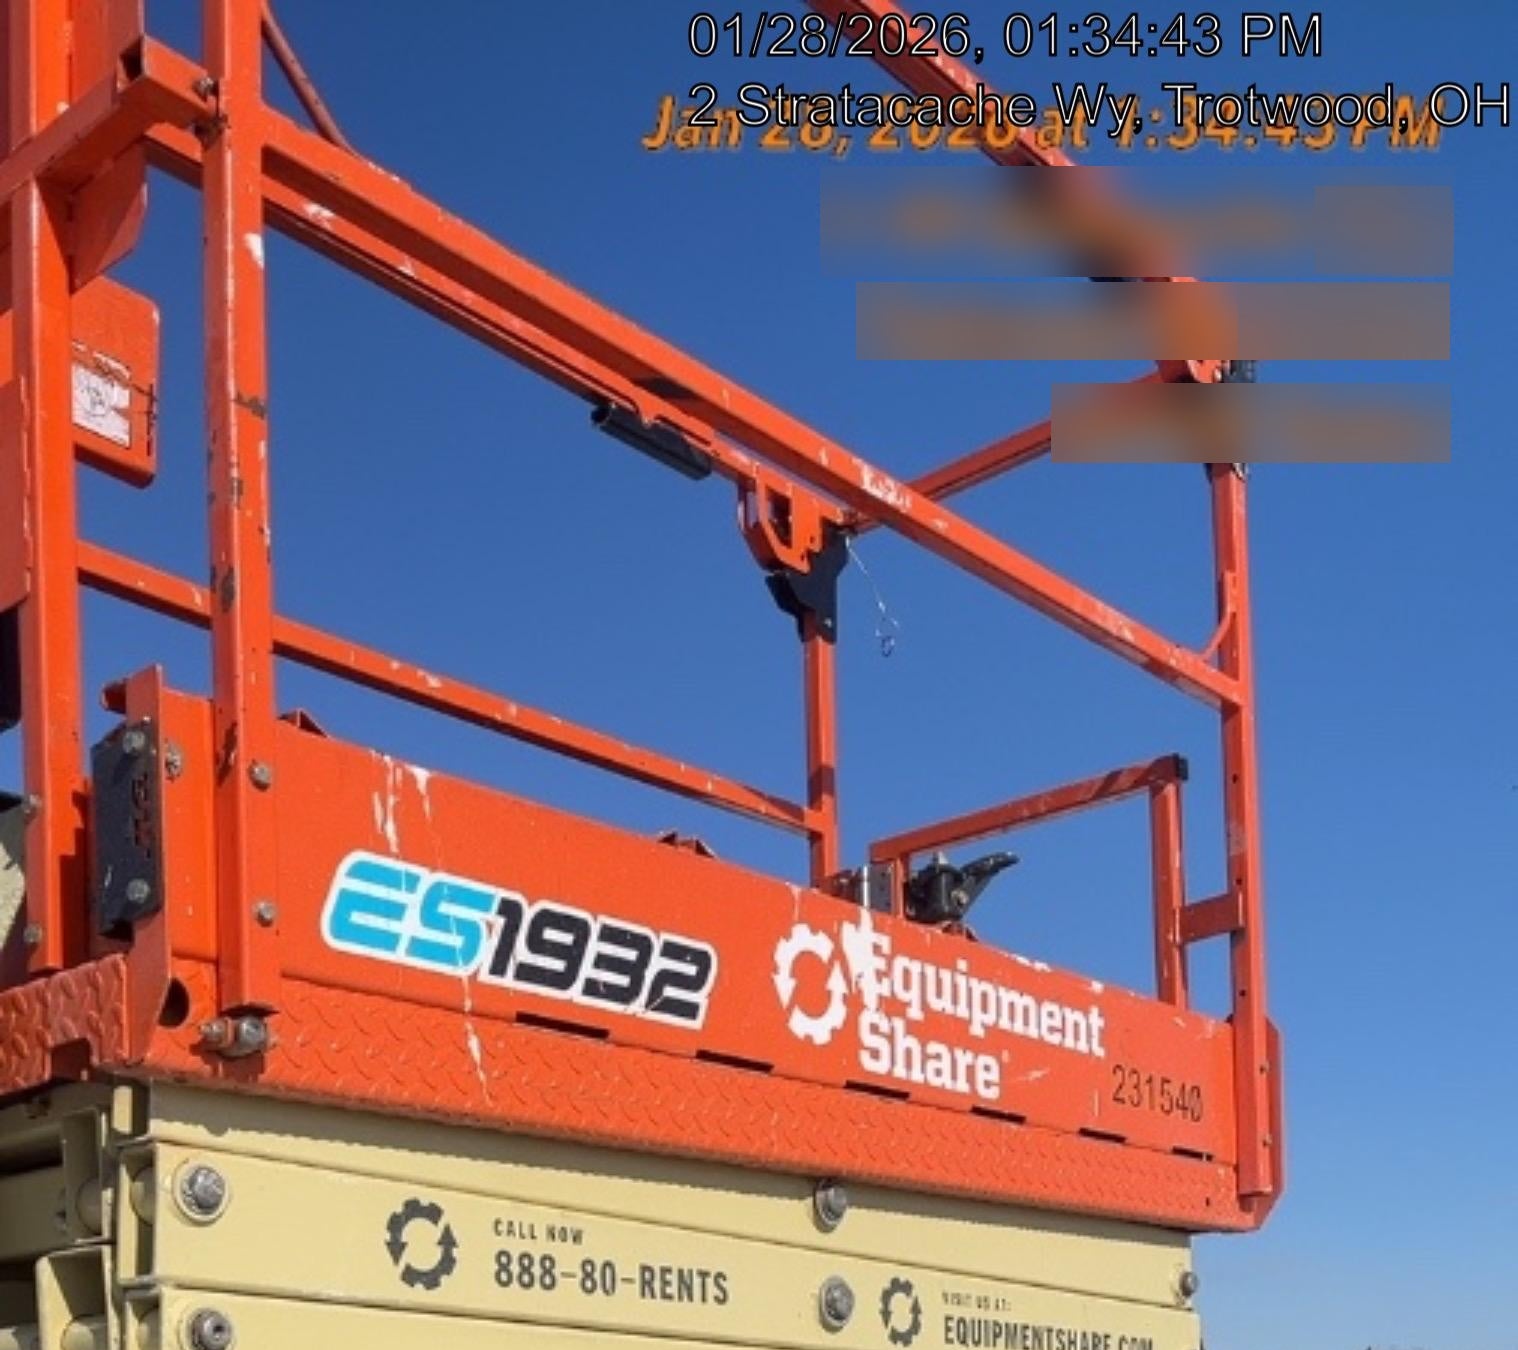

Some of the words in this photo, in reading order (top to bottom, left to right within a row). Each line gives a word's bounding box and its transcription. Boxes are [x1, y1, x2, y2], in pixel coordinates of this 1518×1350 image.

[326, 856, 714, 1023] ES1932
[860, 930, 1105, 1058] Equipment
[858, 1009, 1001, 1100] Share
[1111, 1064, 1204, 1123] 231540
[493, 1217, 538, 1241] CALL
[546, 1223, 585, 1246] NOW
[494, 1249, 730, 1306] 888-80-RENTS
